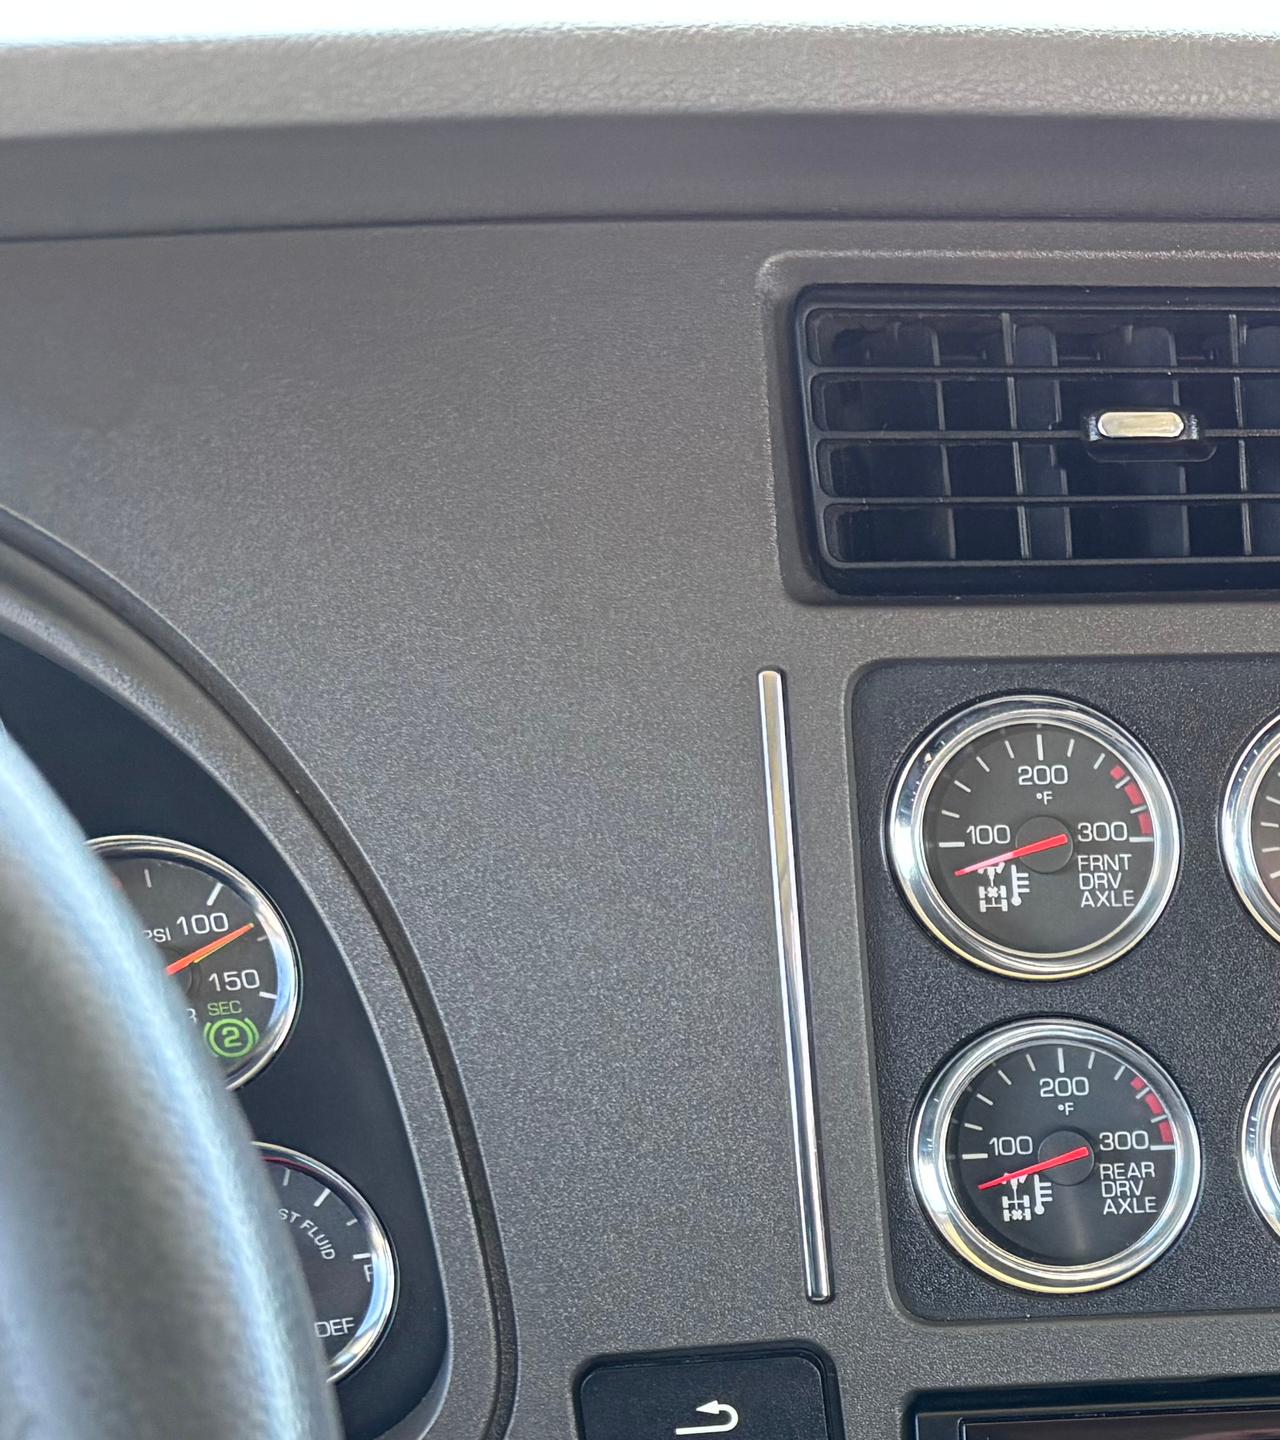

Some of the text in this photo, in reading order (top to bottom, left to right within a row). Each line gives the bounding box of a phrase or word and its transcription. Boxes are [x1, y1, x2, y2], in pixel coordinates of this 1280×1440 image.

[1018, 765, 1068, 785] 200
[967, 825, 1011, 845] 100
[1078, 822, 1128, 842] 300
[1078, 854, 1132, 871] FRNT
[1080, 873, 1122, 889] DRV
[1080, 891, 1135, 907] AXLE
[177, 913, 229, 935] 100
[208, 969, 260, 992] 150
[207, 1000, 242, 1016] SEC
[222, 1026, 242, 1048] 2
[1040, 1077, 1089, 1097] 200
[989, 1136, 1033, 1156] 100
[1100, 1131, 1149, 1151] 300
[1100, 1162, 1155, 1179] REAR
[1102, 1181, 1143, 1197] DRV
[1103, 1197, 1157, 1215] AXLE
[299, 1219, 336, 1260] FLUID
[314, 1317, 355, 1338] DEF
